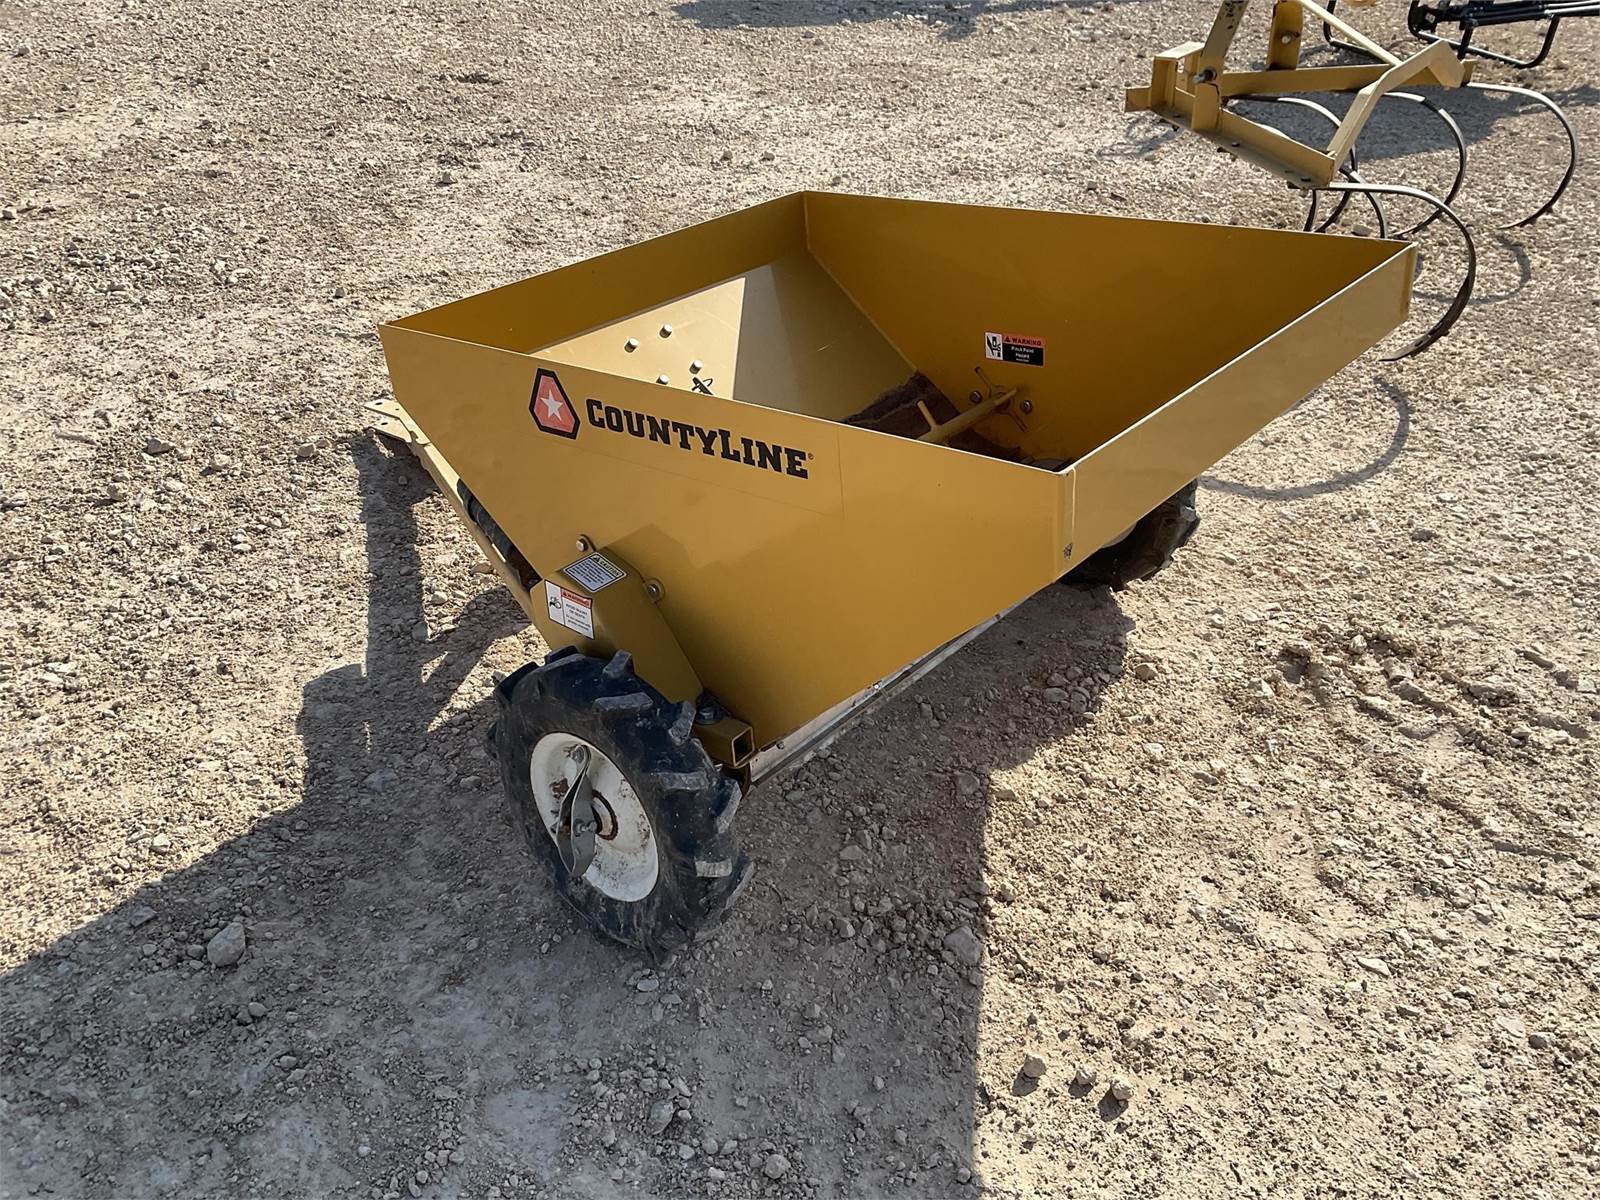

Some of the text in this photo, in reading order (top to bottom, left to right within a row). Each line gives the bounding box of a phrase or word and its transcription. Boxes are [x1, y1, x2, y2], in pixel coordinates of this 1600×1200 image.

[1012, 337, 1042, 346] WARNING
[586, 398, 810, 480] COUNTYLINE
[600, 560, 620, 577] CAUTION
